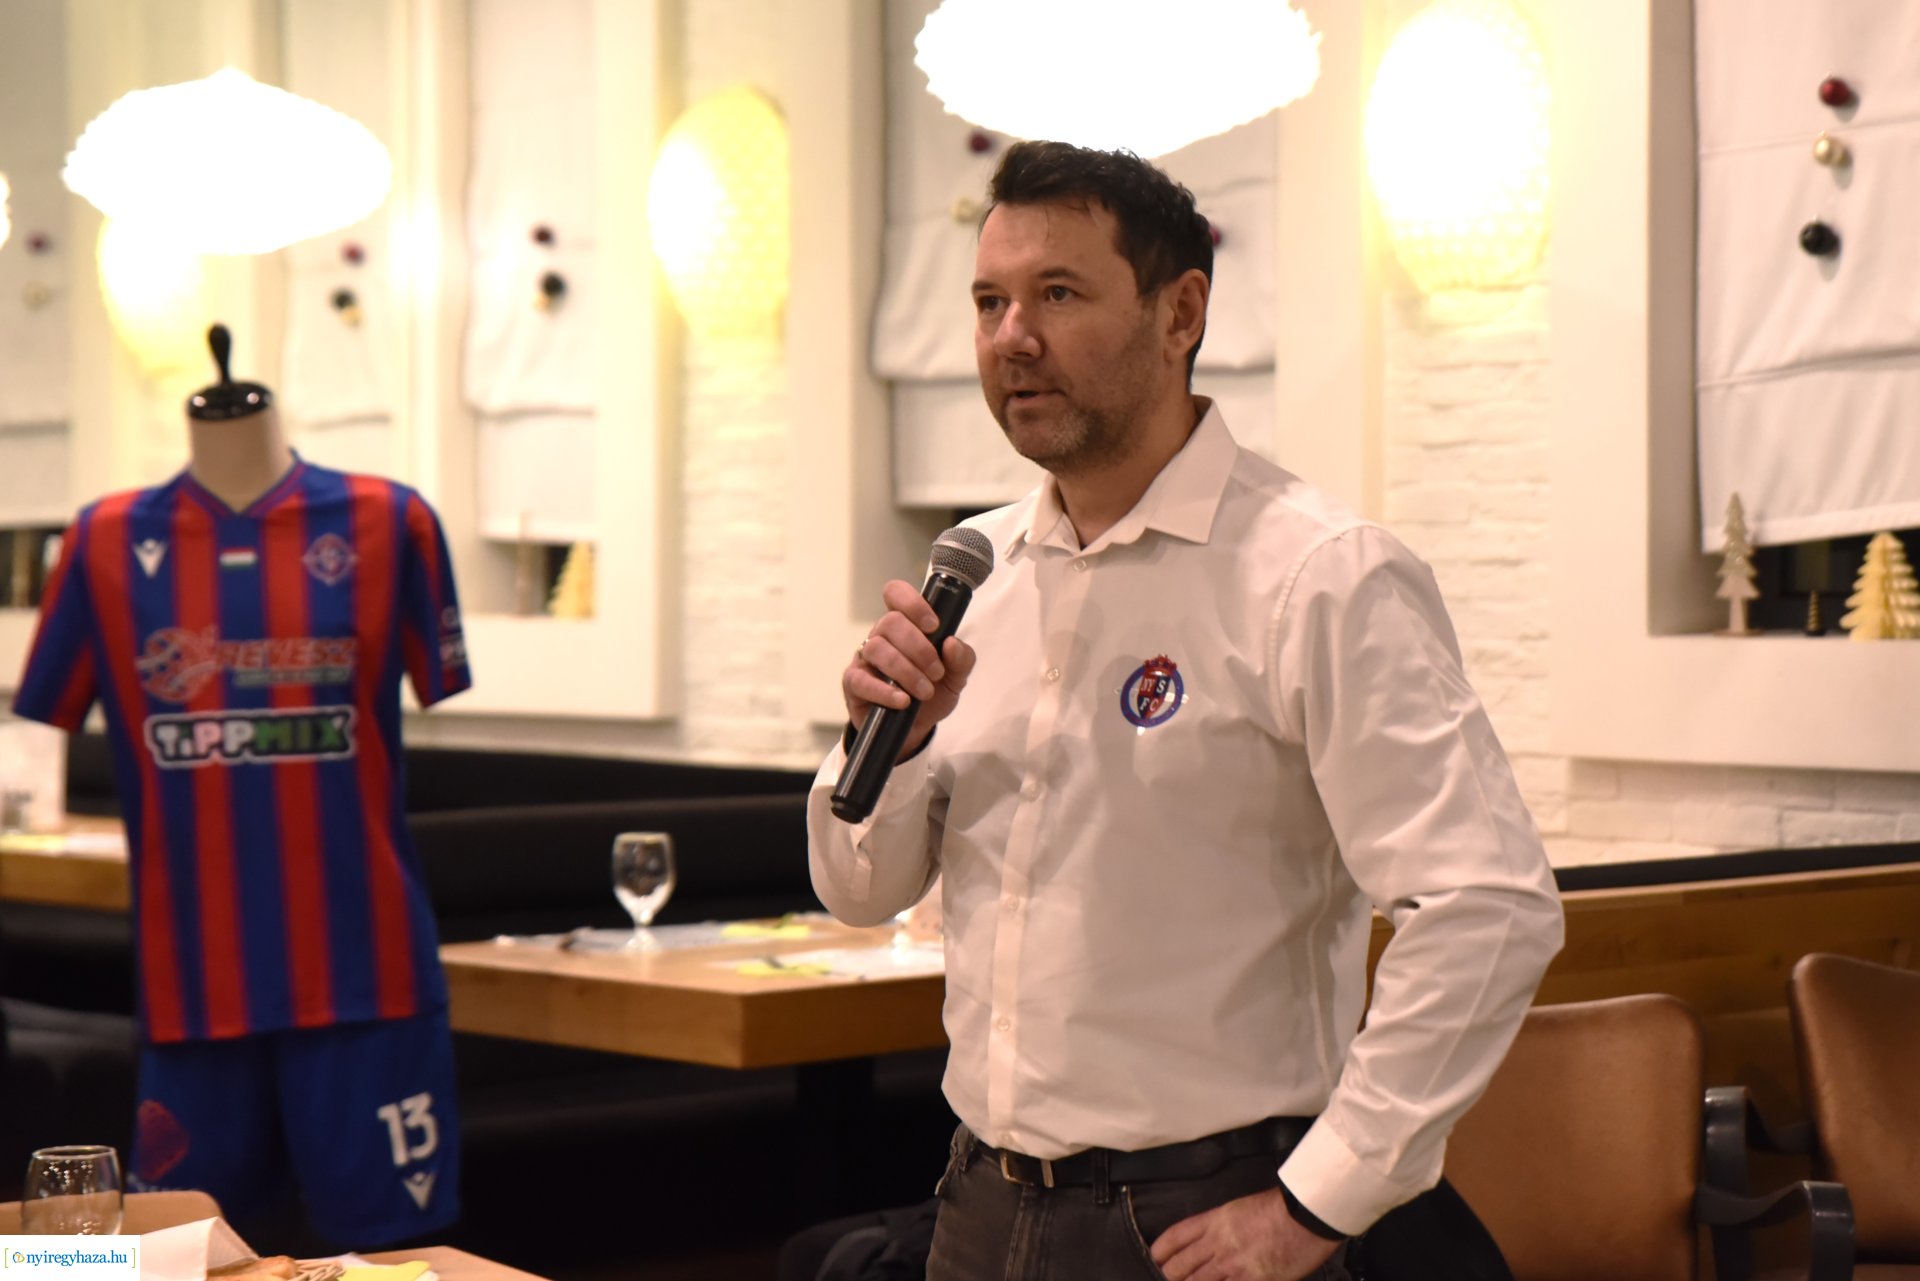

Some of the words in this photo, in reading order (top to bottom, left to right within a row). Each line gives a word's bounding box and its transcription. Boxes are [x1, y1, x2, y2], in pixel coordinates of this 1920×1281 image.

[1156, 680, 1166, 693] S
[1150, 698, 1159, 712] C
[377, 1092, 438, 1166] 13
